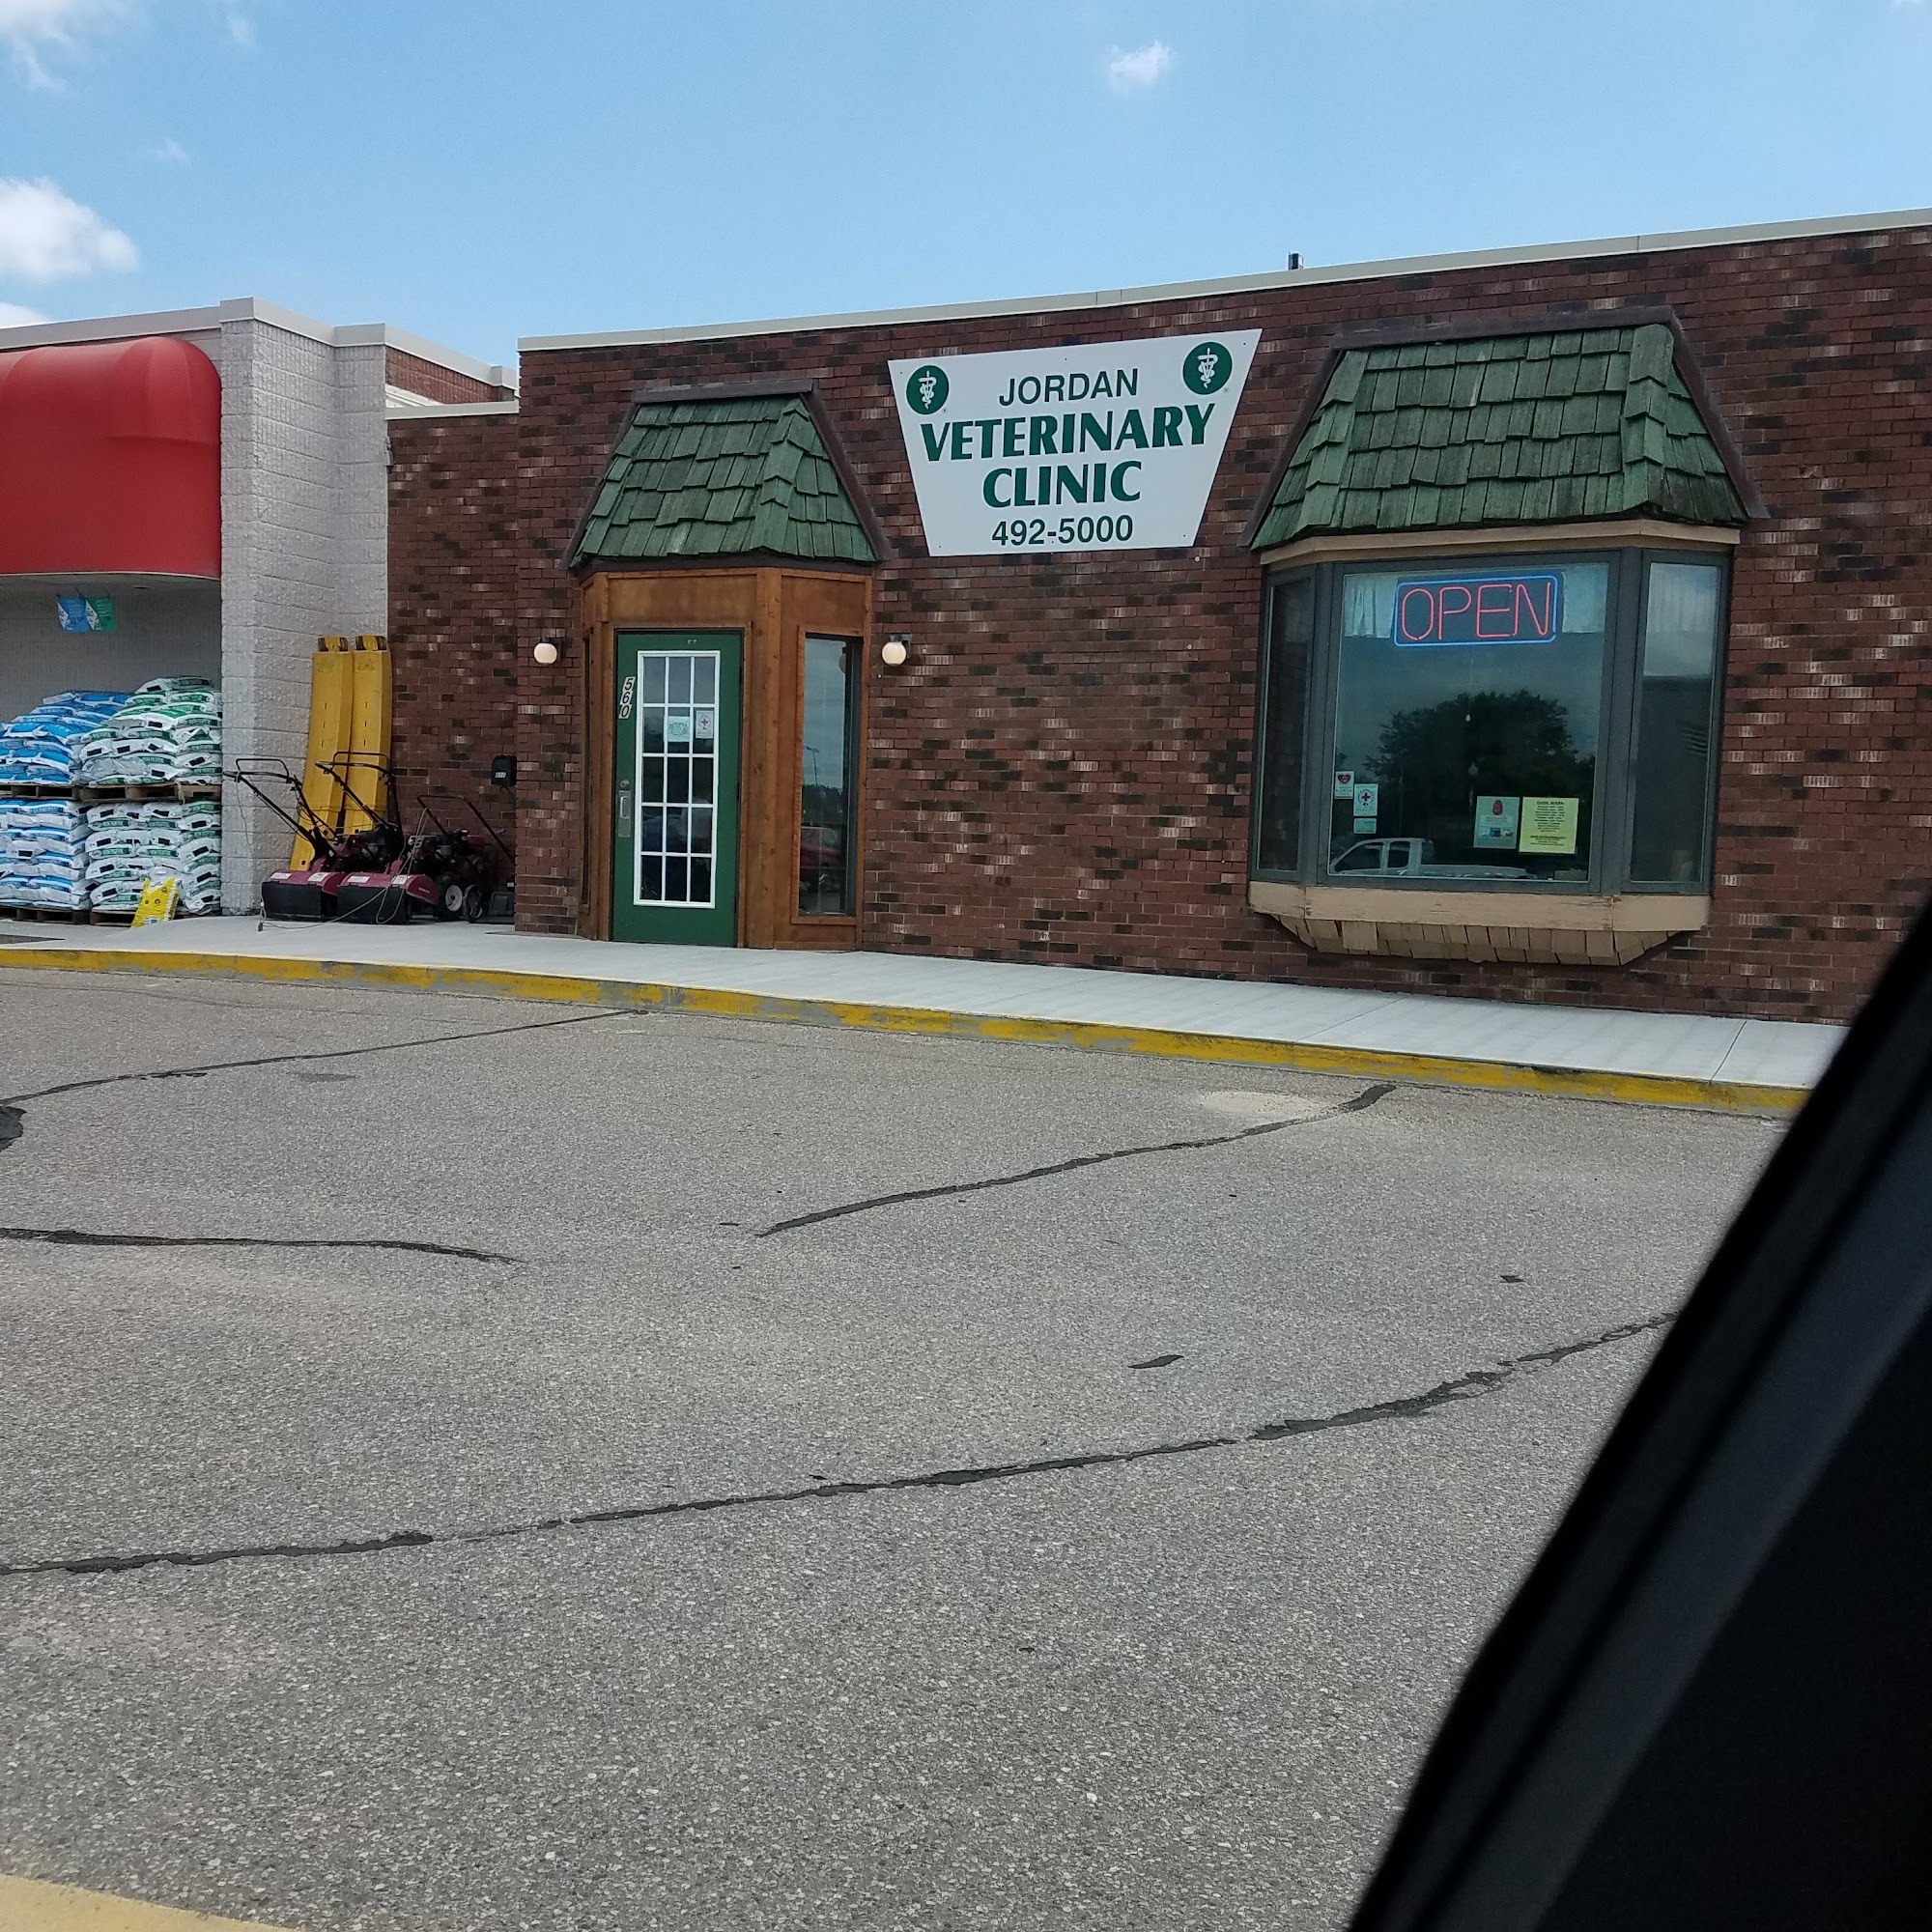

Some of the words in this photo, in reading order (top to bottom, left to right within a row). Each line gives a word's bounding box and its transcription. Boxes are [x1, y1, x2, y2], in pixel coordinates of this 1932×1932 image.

[999, 368, 1139, 406] JORDAN
[921, 403, 1215, 462] VETERINARY
[982, 461, 1142, 508] CLINIC
[991, 514, 1133, 547] 492-5000
[1401, 582, 1551, 640] OPEN
[621, 677, 634, 718] 560
